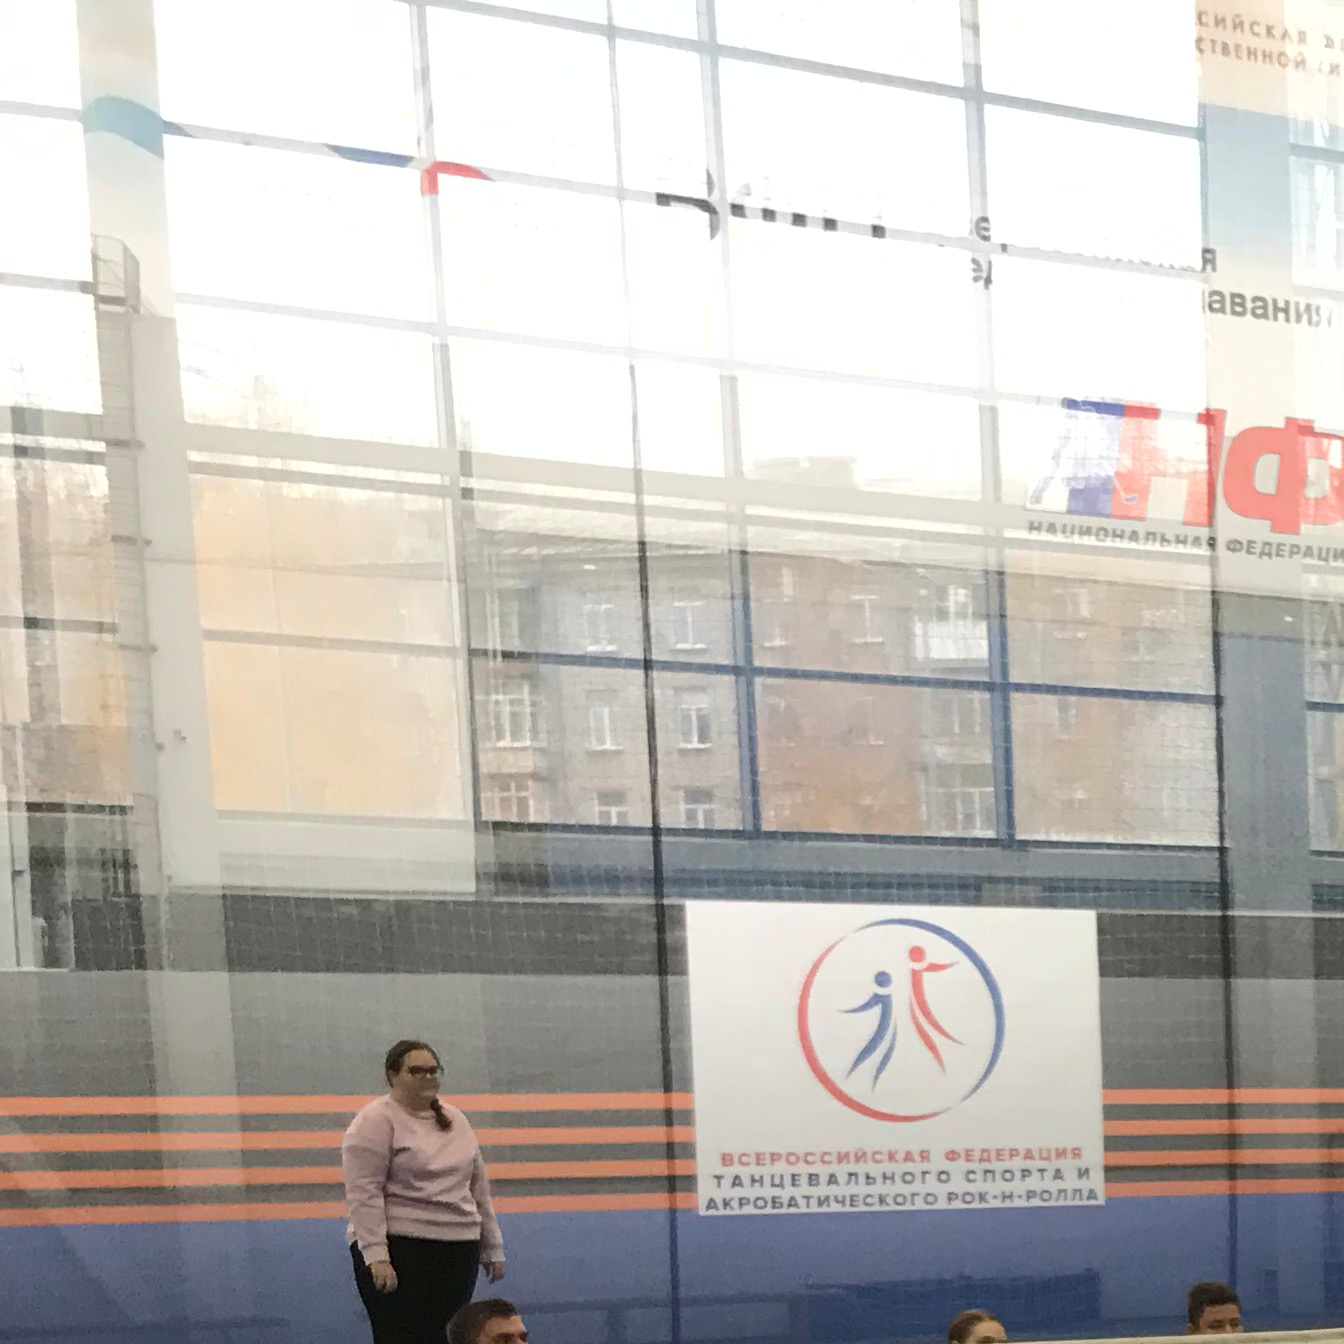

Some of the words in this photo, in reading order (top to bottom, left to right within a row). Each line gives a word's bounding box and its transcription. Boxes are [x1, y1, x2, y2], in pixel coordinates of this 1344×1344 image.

[1196, 10, 1308, 46] СИЙСКАЯ
[1195, 37, 1307, 72] СТВЕННОЙ
[1201, 287, 1333, 329] авания
[1027, 518, 1216, 552] НАЦИОНАЛЬНАЯ
[720, 1149, 932, 1168] ВСЕРОССИЙСКАЯ
[944, 1146, 1084, 1165] ФЕДЕРАЦИЯ
[713, 1168, 952, 1190] ТАНЦЕВАЛЬНОГО
[965, 1167, 1064, 1184] СПОРТА
[1077, 1167, 1091, 1181] И
[705, 1191, 938, 1213] АКРОБАТИЧЕСКОГО
[946, 1187, 1100, 1205] РОК-Н-РОЛЛА
